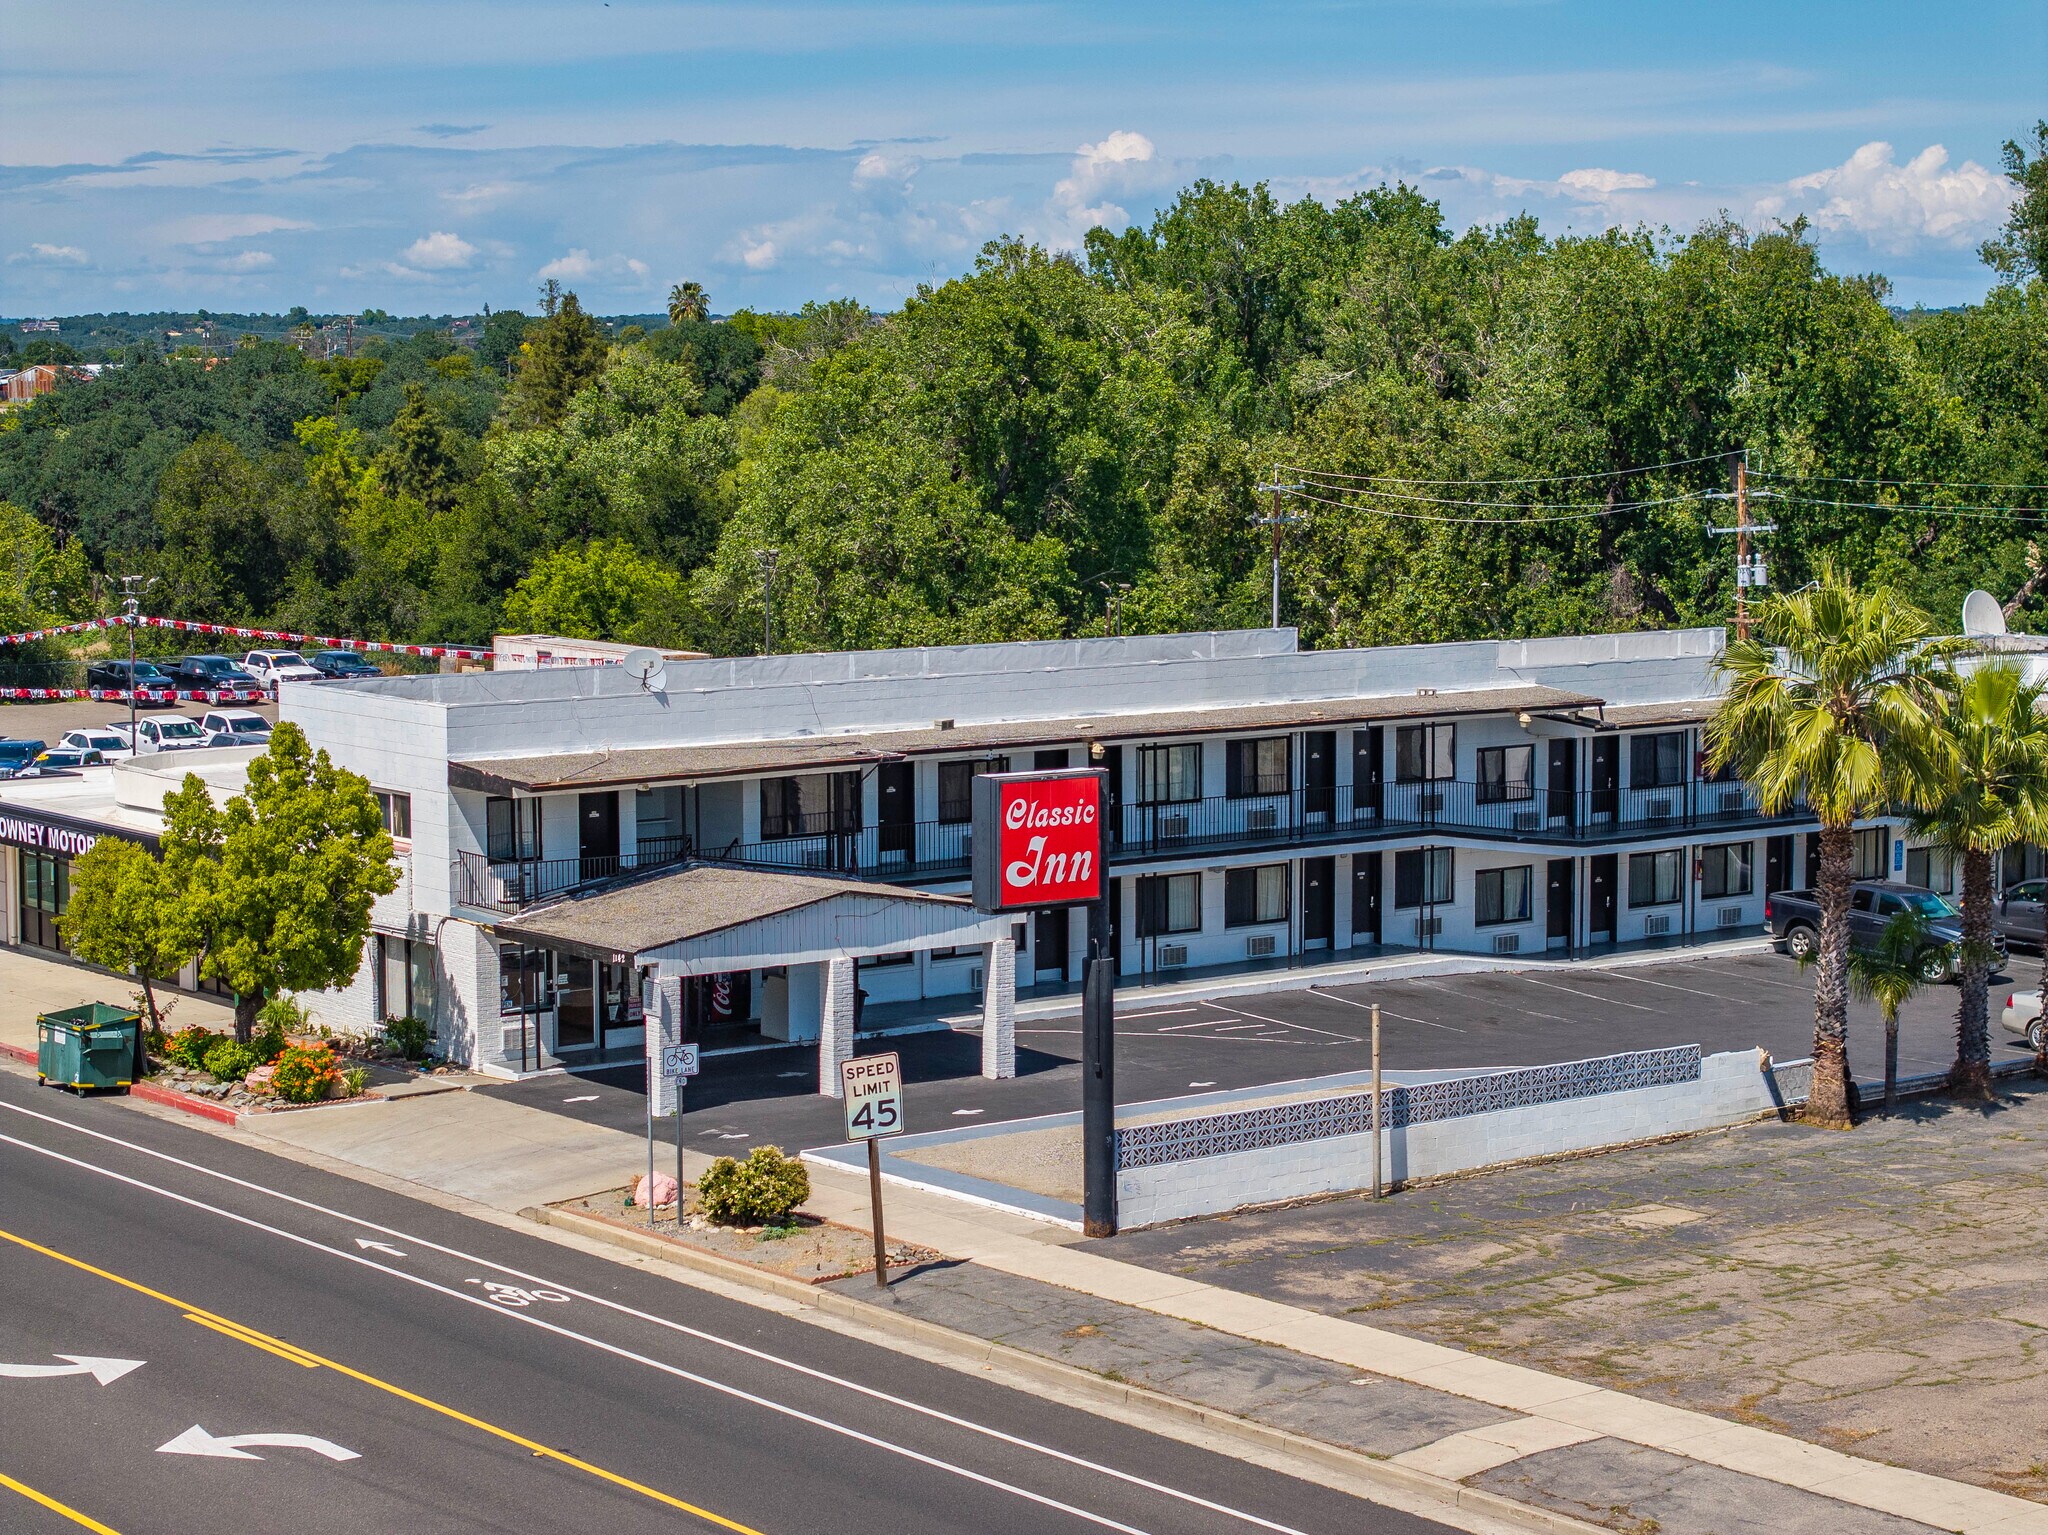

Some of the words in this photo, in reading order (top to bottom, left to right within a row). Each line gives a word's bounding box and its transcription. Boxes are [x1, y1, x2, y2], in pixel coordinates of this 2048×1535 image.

[1006, 798, 1095, 830] Classic
[0, 817, 44, 846] OWNEY
[48, 827, 101, 855] MOTOR
[1006, 835, 1092, 887] Inn
[666, 1067, 679, 1075] BIKE
[681, 1066, 695, 1074] LANE
[846, 1061, 894, 1080] SPEED
[853, 1080, 890, 1097] LIMIT
[851, 1098, 897, 1130] 45
